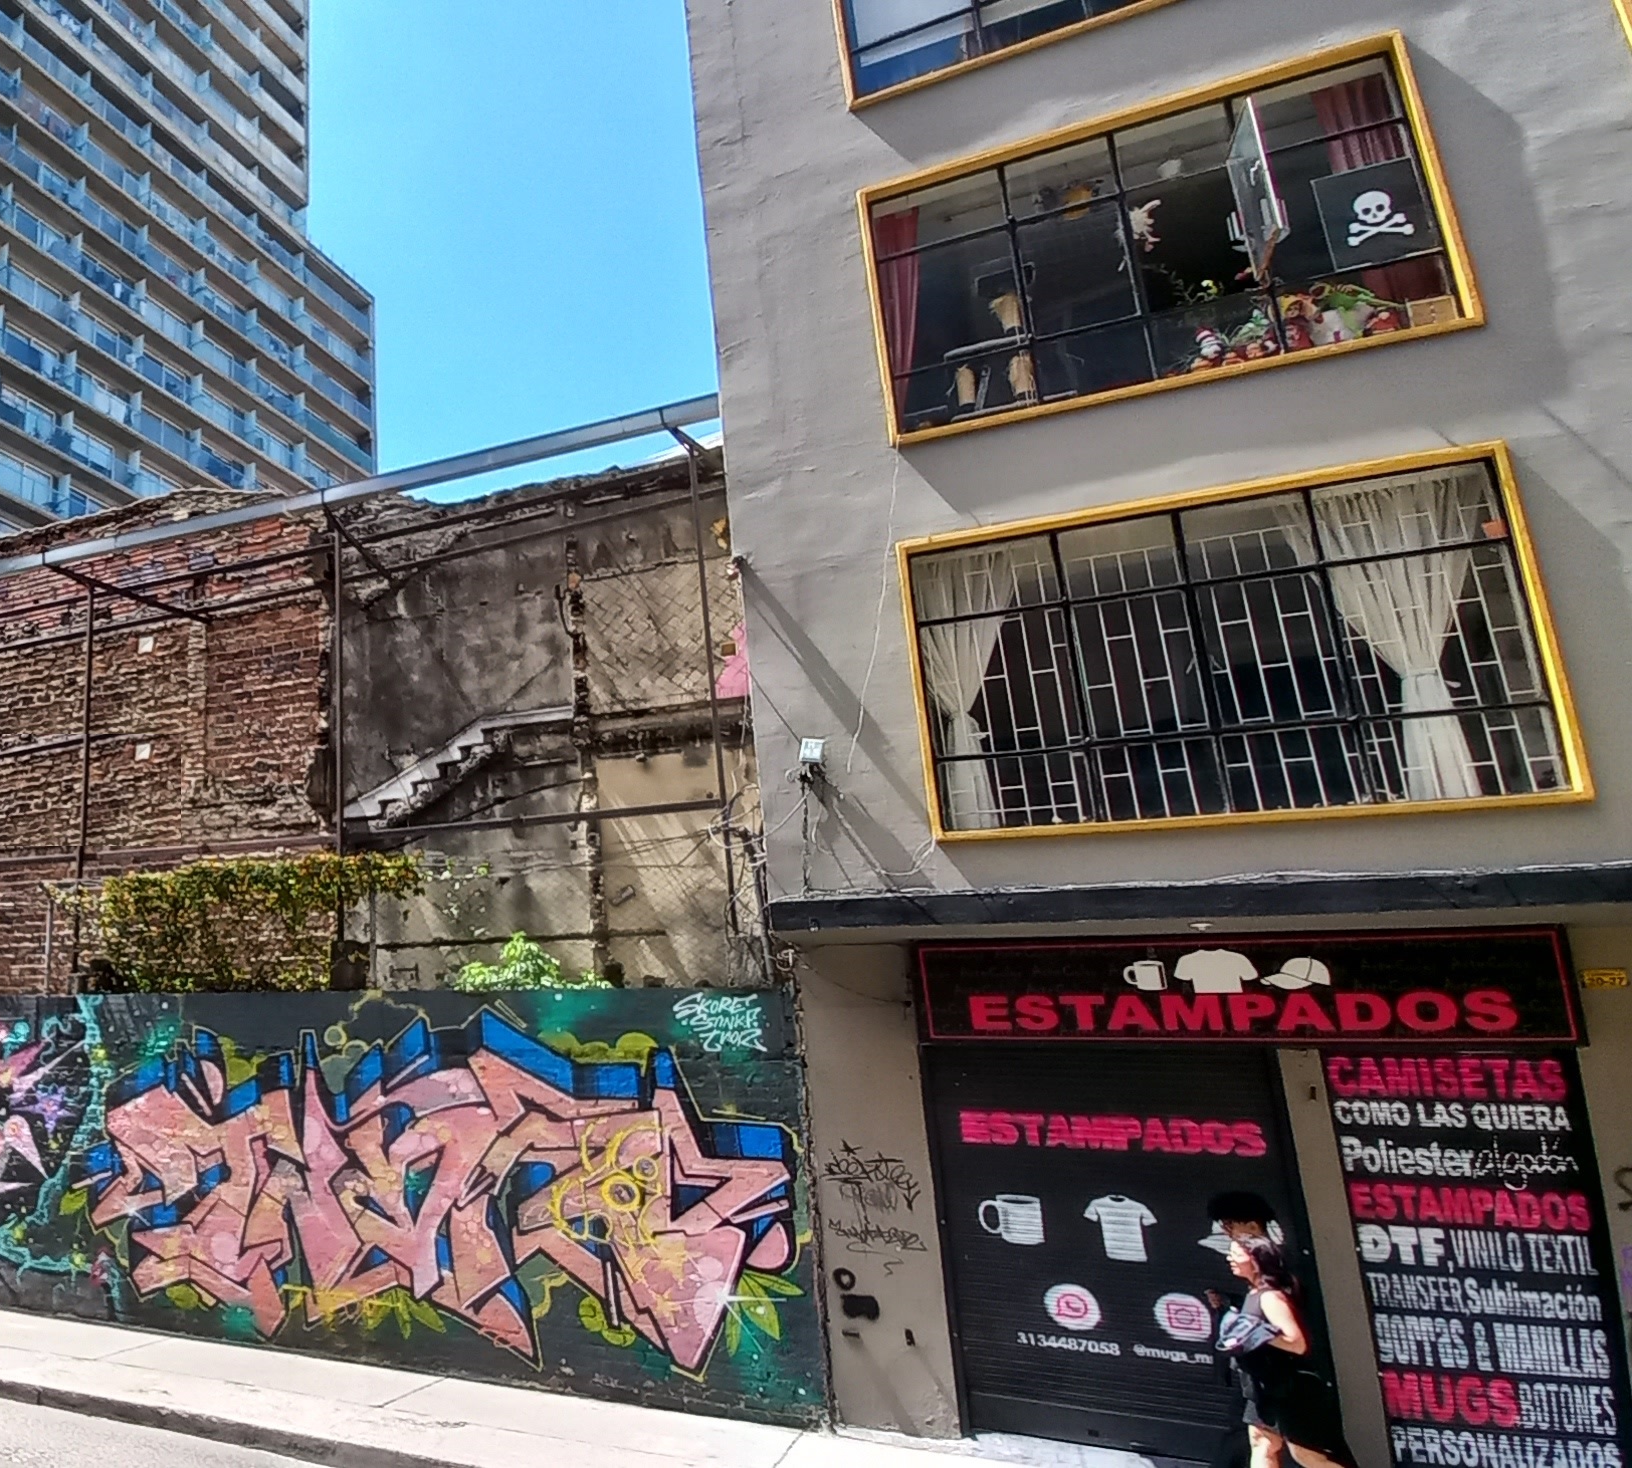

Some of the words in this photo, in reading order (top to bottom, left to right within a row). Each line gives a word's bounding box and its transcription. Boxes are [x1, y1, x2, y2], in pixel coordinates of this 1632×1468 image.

[969, 990, 1519, 1032] ESTAMPADOS
[1328, 1056, 1567, 1100] CAMISETAS
[960, 1110, 1267, 1157] ESTAMPADOS
[1334, 1101, 1411, 1127] COMO
[1417, 1102, 1468, 1129] LAS
[1471, 1103, 1572, 1131] QUIERA
[1349, 1182, 1591, 1231] ESTAMPADOS
[1450, 1229, 1524, 1273] VINILO
[1524, 1234, 1600, 1276] TEXTIL
[1465, 1277, 1603, 1322] Sublimación
[1017, 1331, 1121, 1356] 3134487058
[1473, 1321, 1495, 1372] &
[1493, 1322, 1612, 1379] MANILLAS
[1518, 1382, 1618, 1436] BOTONES
[1389, 1426, 1624, 1468] PERSONALIZADOS
